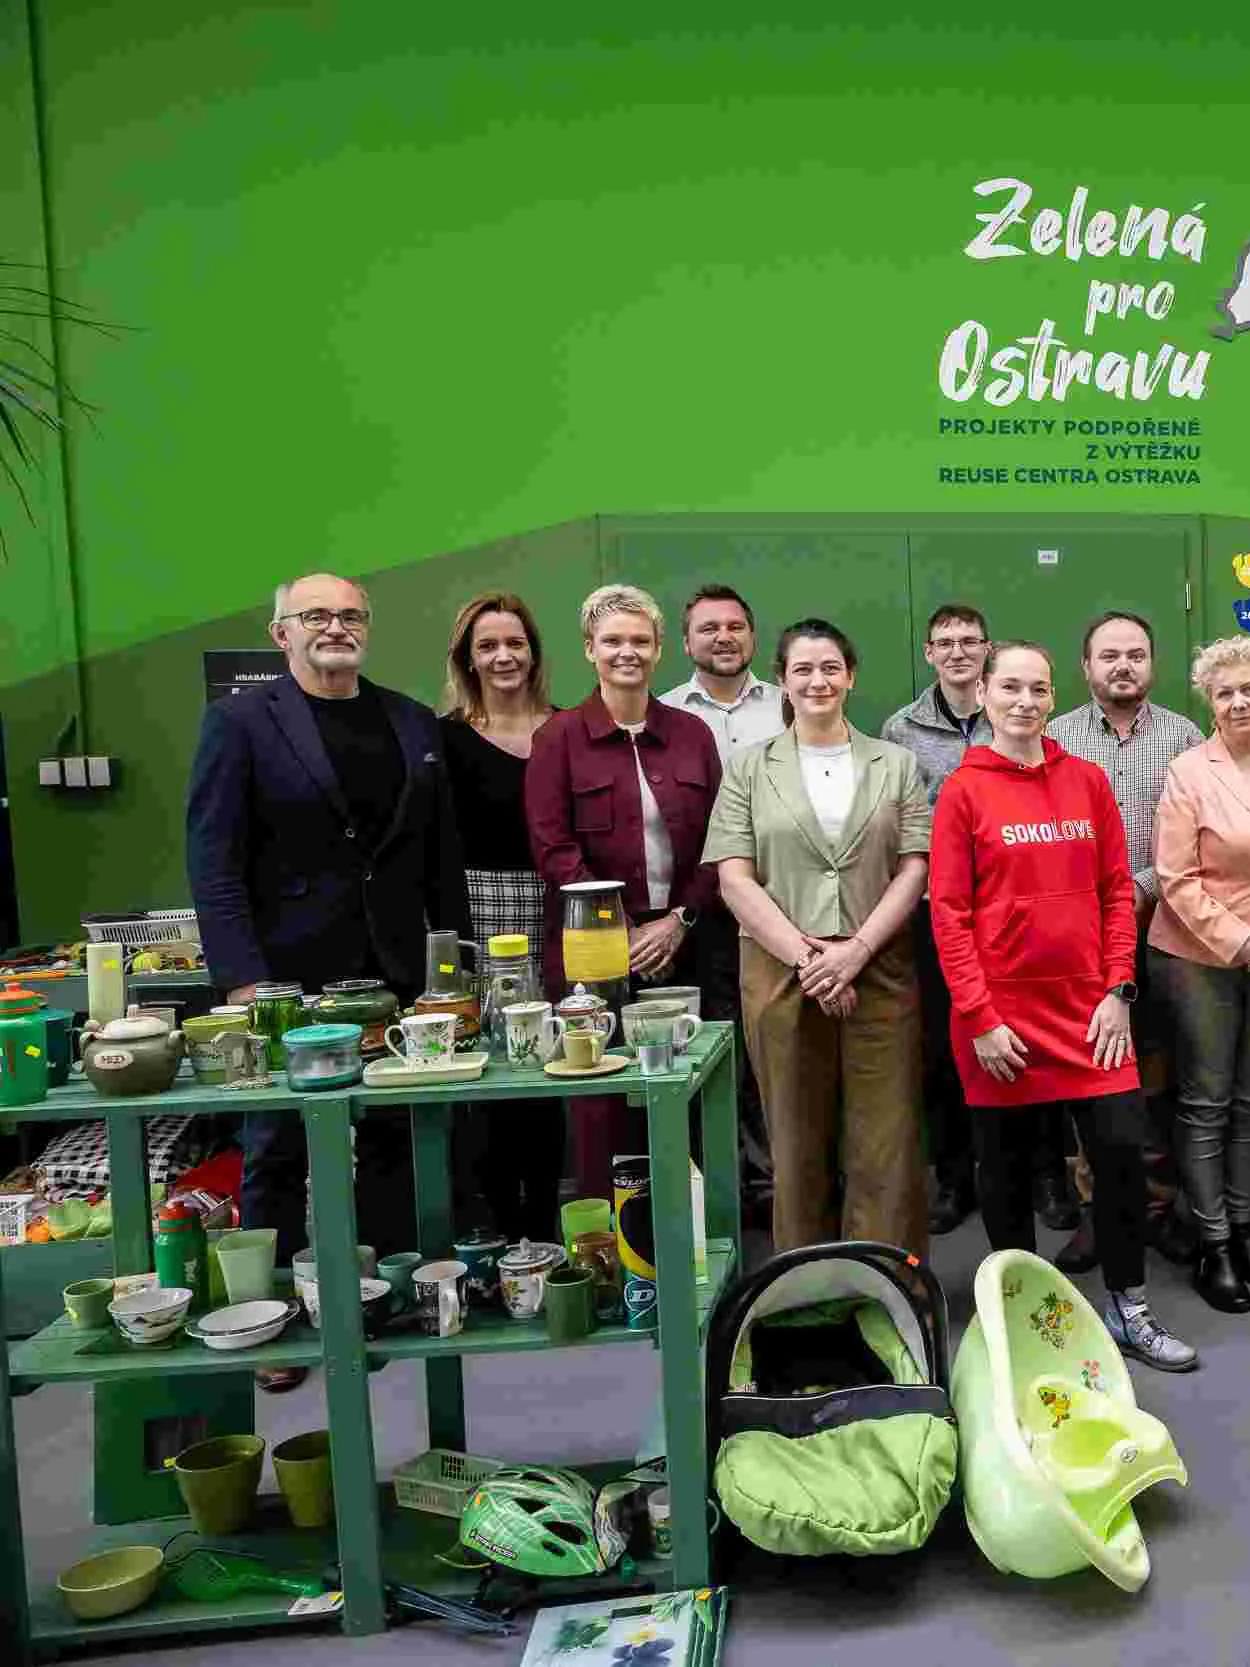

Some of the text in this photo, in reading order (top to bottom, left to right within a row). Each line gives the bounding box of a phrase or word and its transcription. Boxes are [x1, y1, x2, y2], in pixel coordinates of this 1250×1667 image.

[963, 177, 1208, 263] Zelená
[1084, 279, 1176, 336] pro
[938, 318, 1211, 407] Ostravu
[938, 416, 1201, 436] PROJEKTY PODPOŘENÉ
[1086, 441, 1201, 461] Z VÝTĚŽKU
[938, 468, 1201, 484] REUSE CENTRA OSTRAVA
[1000, 819, 1097, 846] SOKOLOVE
[629, 1288, 655, 1303] D
